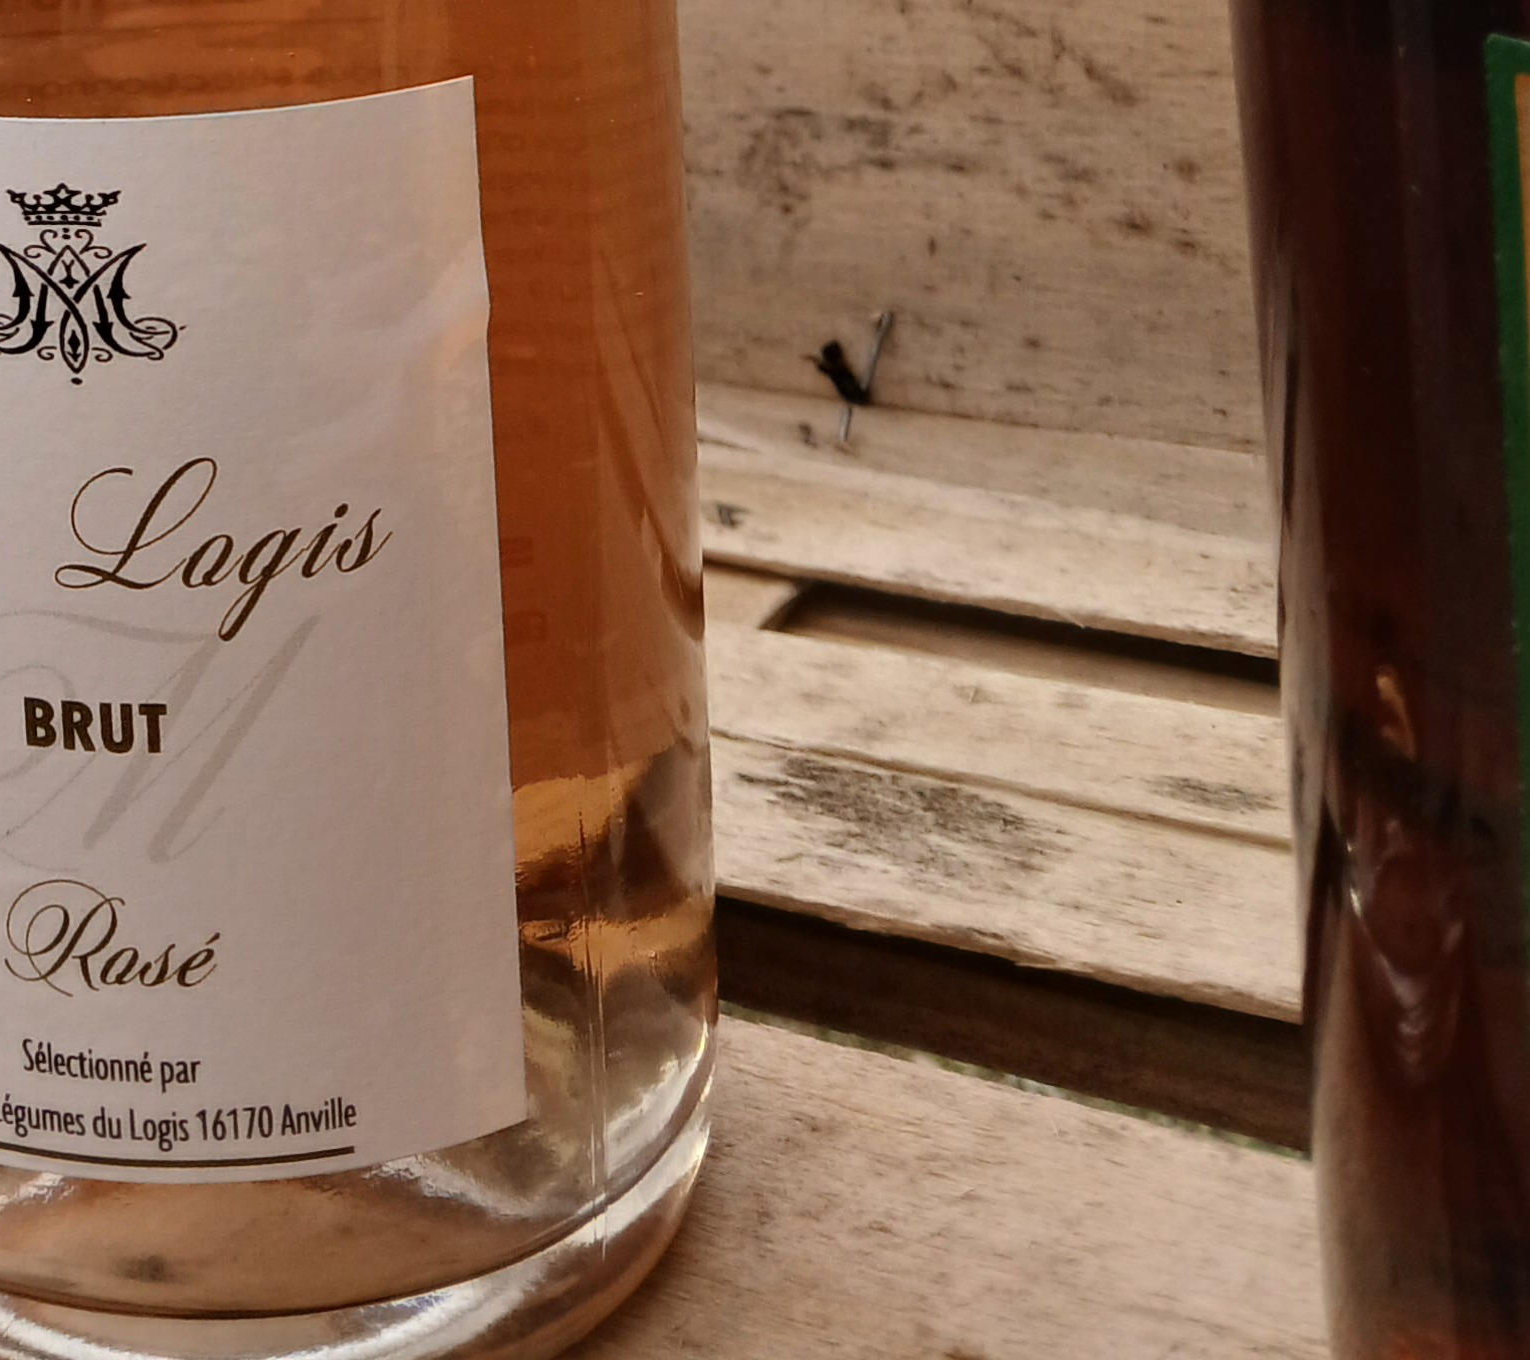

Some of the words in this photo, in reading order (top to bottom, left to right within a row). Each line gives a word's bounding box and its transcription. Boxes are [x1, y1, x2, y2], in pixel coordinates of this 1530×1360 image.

[54, 457, 394, 641] Logis
[23, 697, 168, 754] BRUT
[4, 879, 222, 997] Rosé
[22, 1038, 153, 1083] Sélectionné
[160, 1060, 201, 1093] par
[92, 1106, 122, 1139] du
[129, 1108, 189, 1152] Logis
[195, 1105, 273, 1141] 16170
[281, 1097, 357, 1136] Anville
